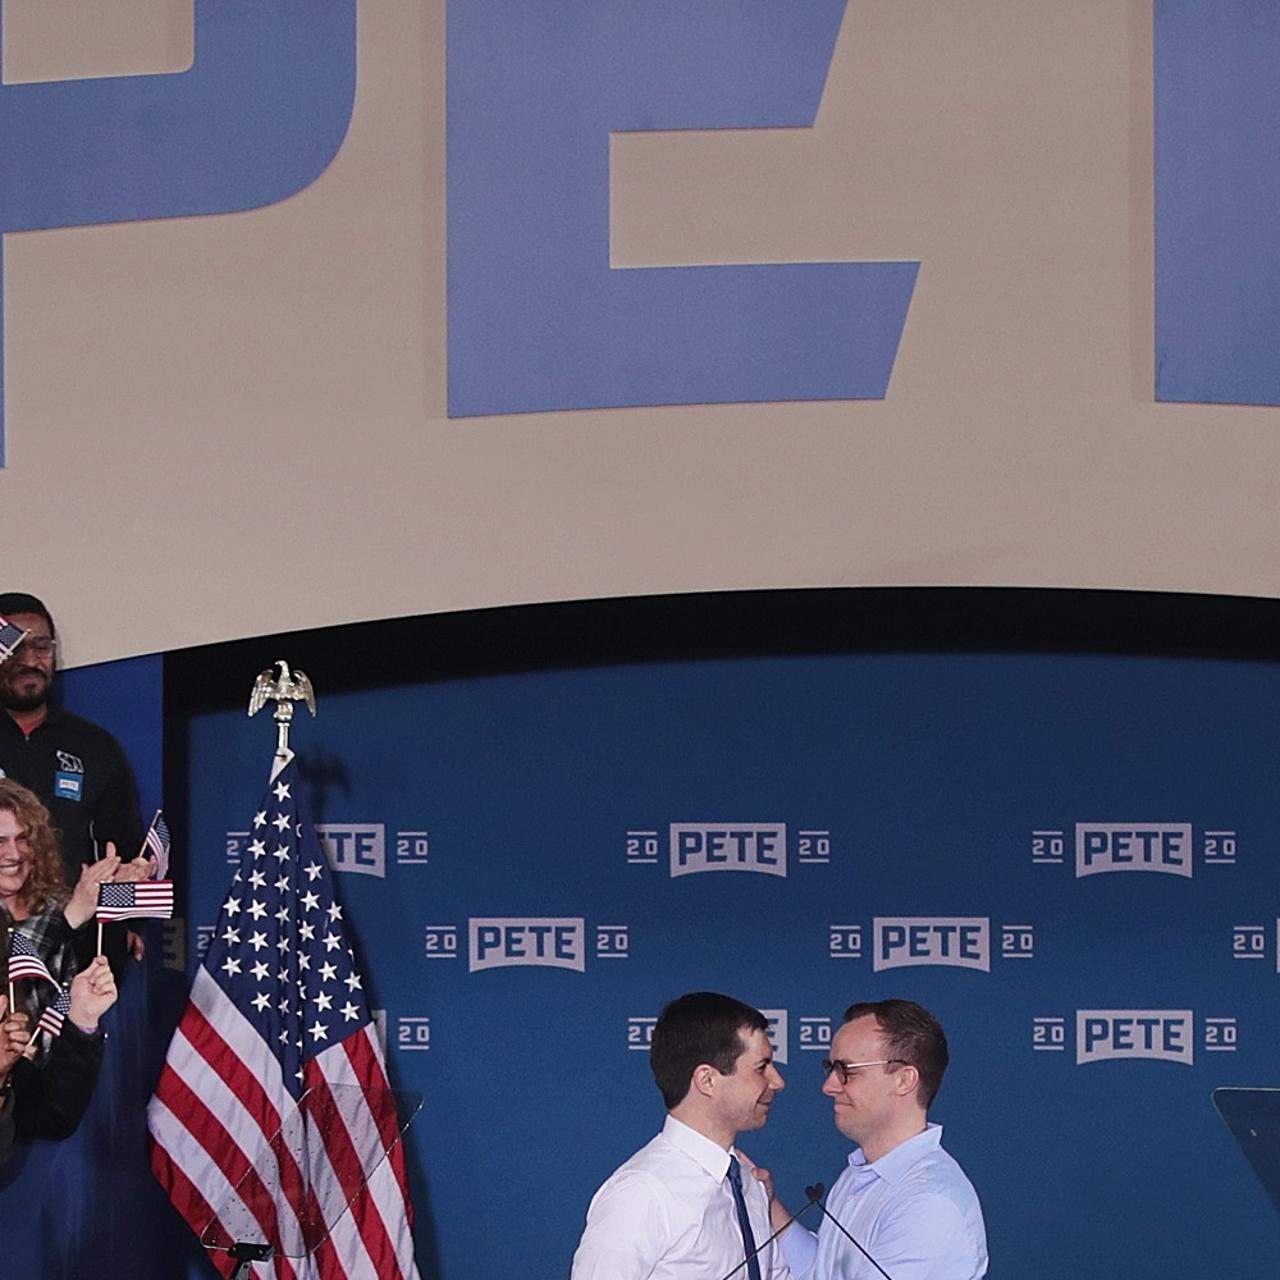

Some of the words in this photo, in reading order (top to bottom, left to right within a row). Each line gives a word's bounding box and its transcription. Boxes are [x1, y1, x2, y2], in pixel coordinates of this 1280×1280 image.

[318, 832, 376, 866] TE
[397, 839, 428, 856] 20
[627, 839, 658, 856] 20
[678, 831, 779, 866] PETE
[799, 839, 829, 855] 20
[1033, 839, 1063, 856] 20
[1084, 831, 1184, 866] PETE
[1205, 839, 1235, 856] 20
[426, 934, 456, 950] 20
[478, 925, 577, 960] PETE
[597, 934, 627, 950] 20
[830, 934, 860, 950] 20
[882, 925, 981, 960] PETE
[1002, 934, 1033, 950] 20
[1234, 934, 1264, 950] 20
[399, 1026, 429, 1042] 20
[800, 1026, 830, 1042] 20
[1034, 1026, 1064, 1043] 20
[1085, 1018, 1185, 1053] PETE
[1206, 1026, 1236, 1043] 20
